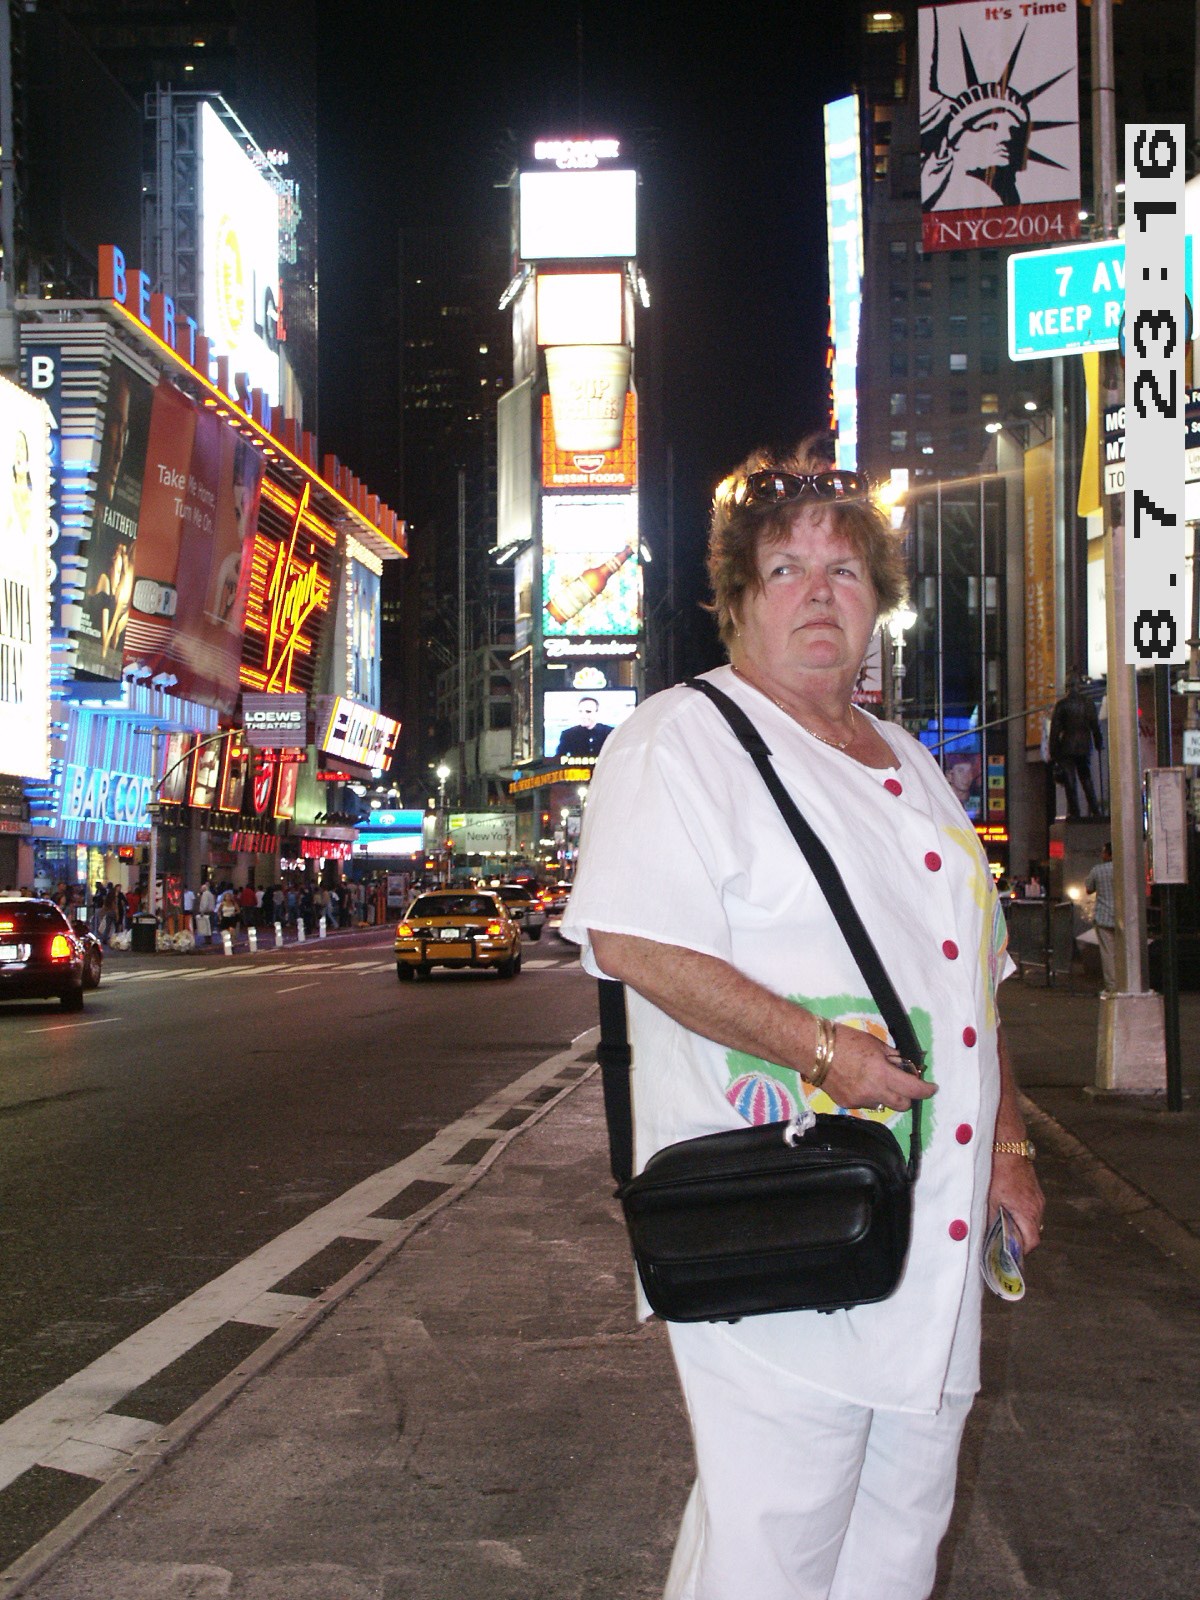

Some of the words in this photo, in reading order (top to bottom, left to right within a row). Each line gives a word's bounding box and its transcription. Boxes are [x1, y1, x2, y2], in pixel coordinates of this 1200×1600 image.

[985, 8, 1012, 20] It's
[1019, 2, 1067, 17] Time
[939, 214, 1064, 243] NYC2004
[1055, 266, 1074, 297] 7
[1029, 304, 1093, 337] KEEP
[157, 464, 186, 490] Take
[590, 473, 625, 483] FOODS
[103, 506, 137, 540] FAITHFUL
[245, 711, 301, 722] LOEWS
[245, 722, 301, 731] THEATRES
[71, 766, 111, 821] BAR
[467, 832, 489, 841] New
[490, 832, 511, 841] Yor
